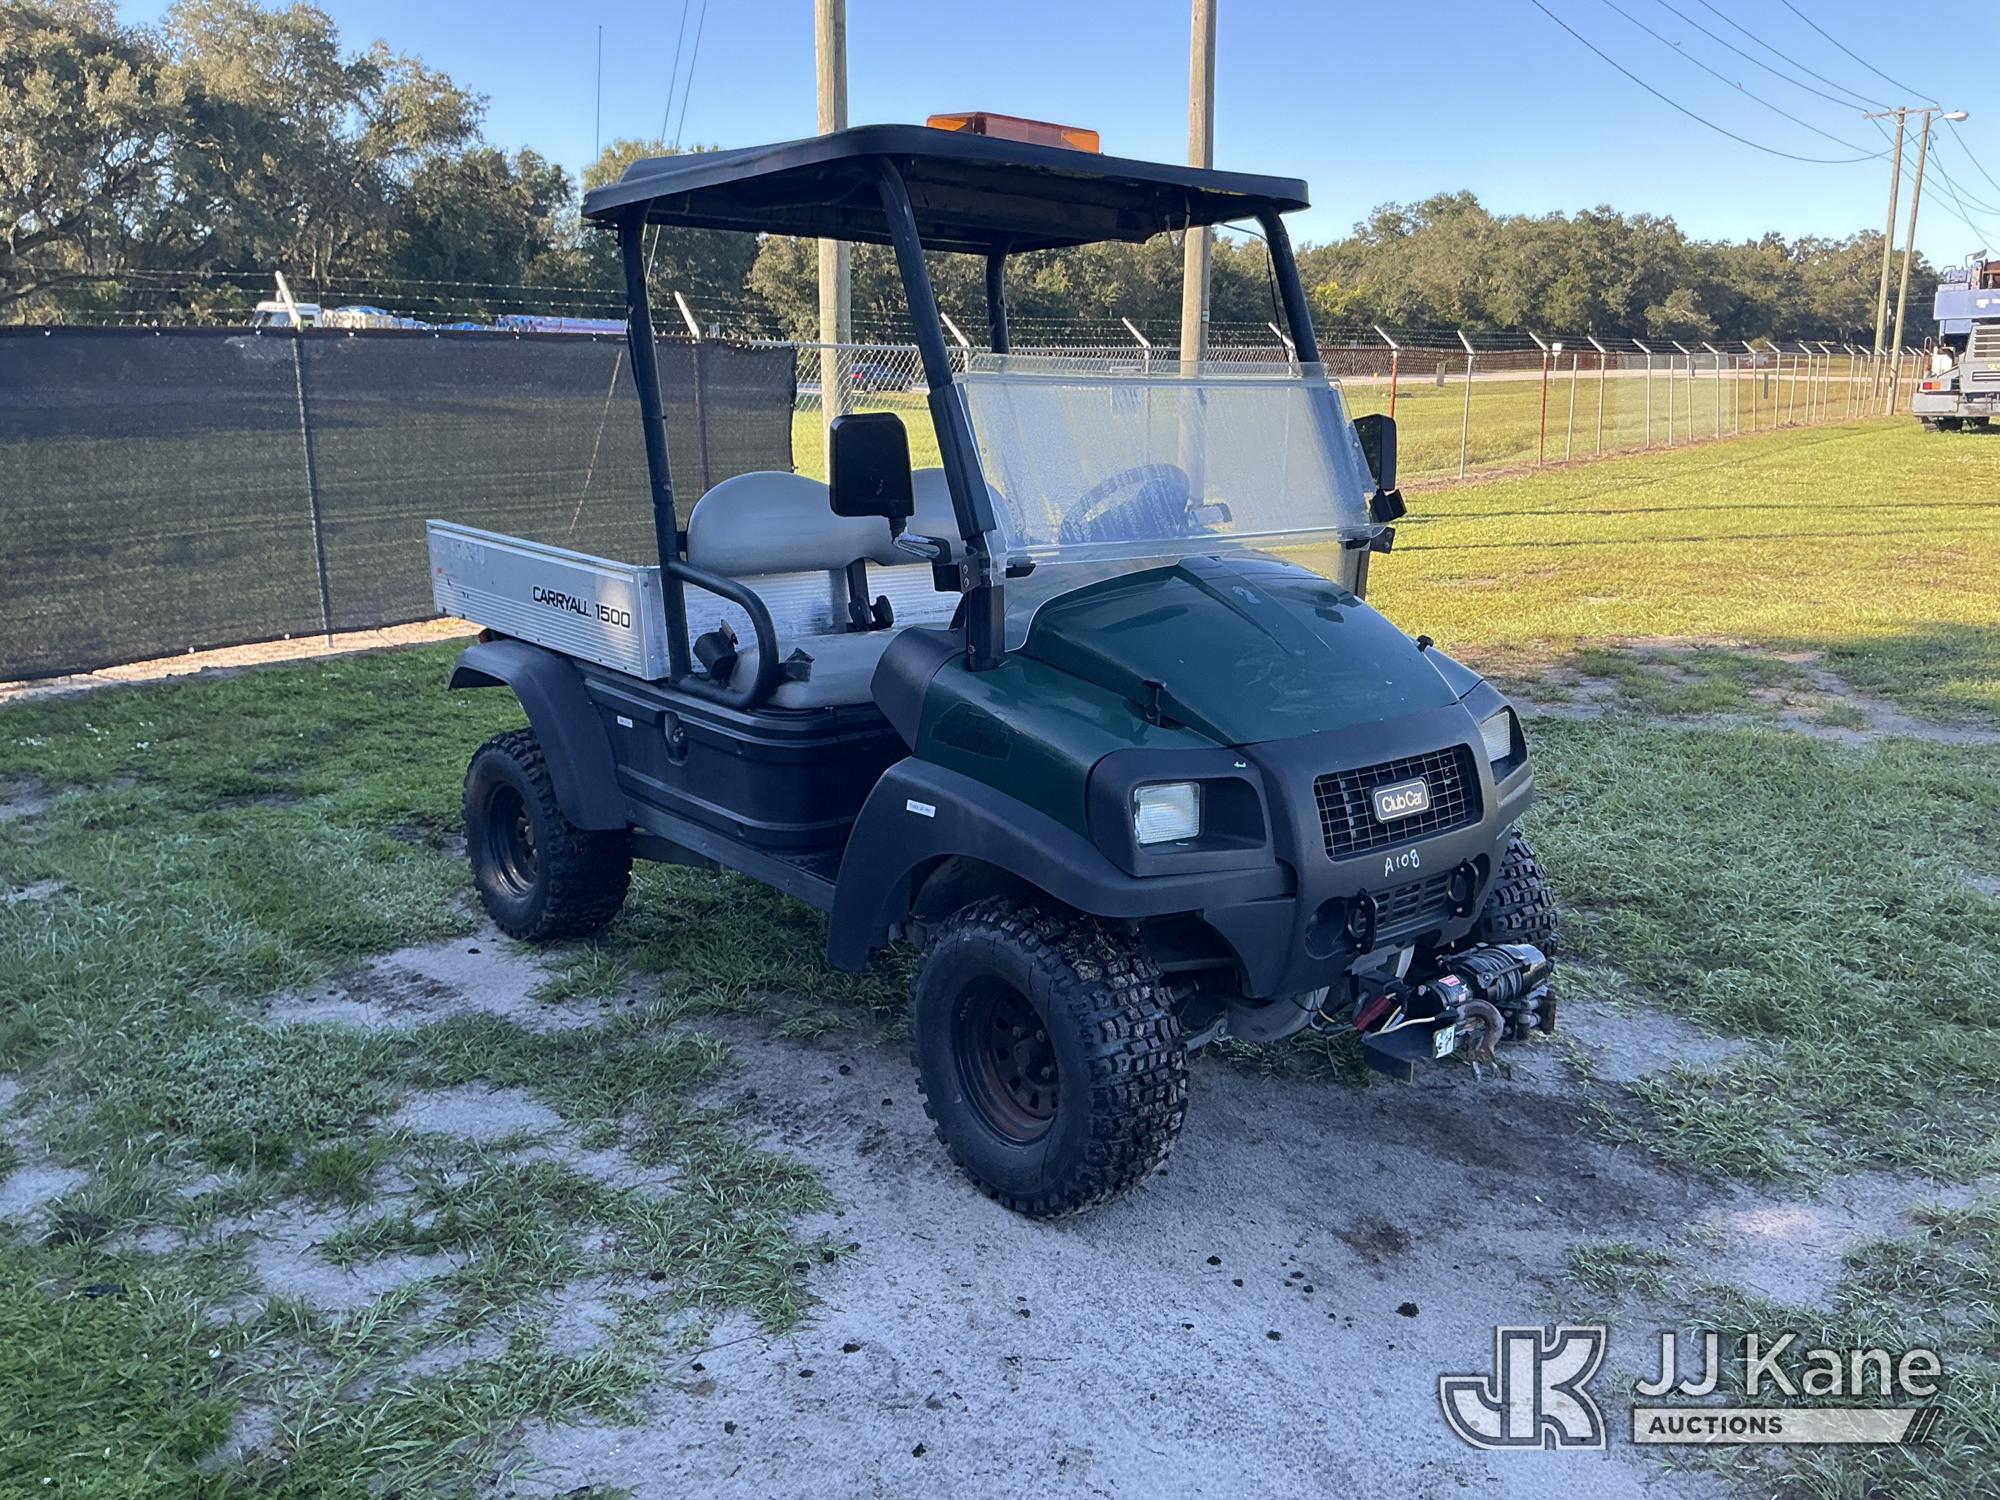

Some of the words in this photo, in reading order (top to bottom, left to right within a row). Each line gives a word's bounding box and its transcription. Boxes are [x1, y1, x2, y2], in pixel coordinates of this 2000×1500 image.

[532, 586, 592, 618] CARRYALL
[596, 603, 631, 629] 1500
[1384, 849, 1421, 877] A108
